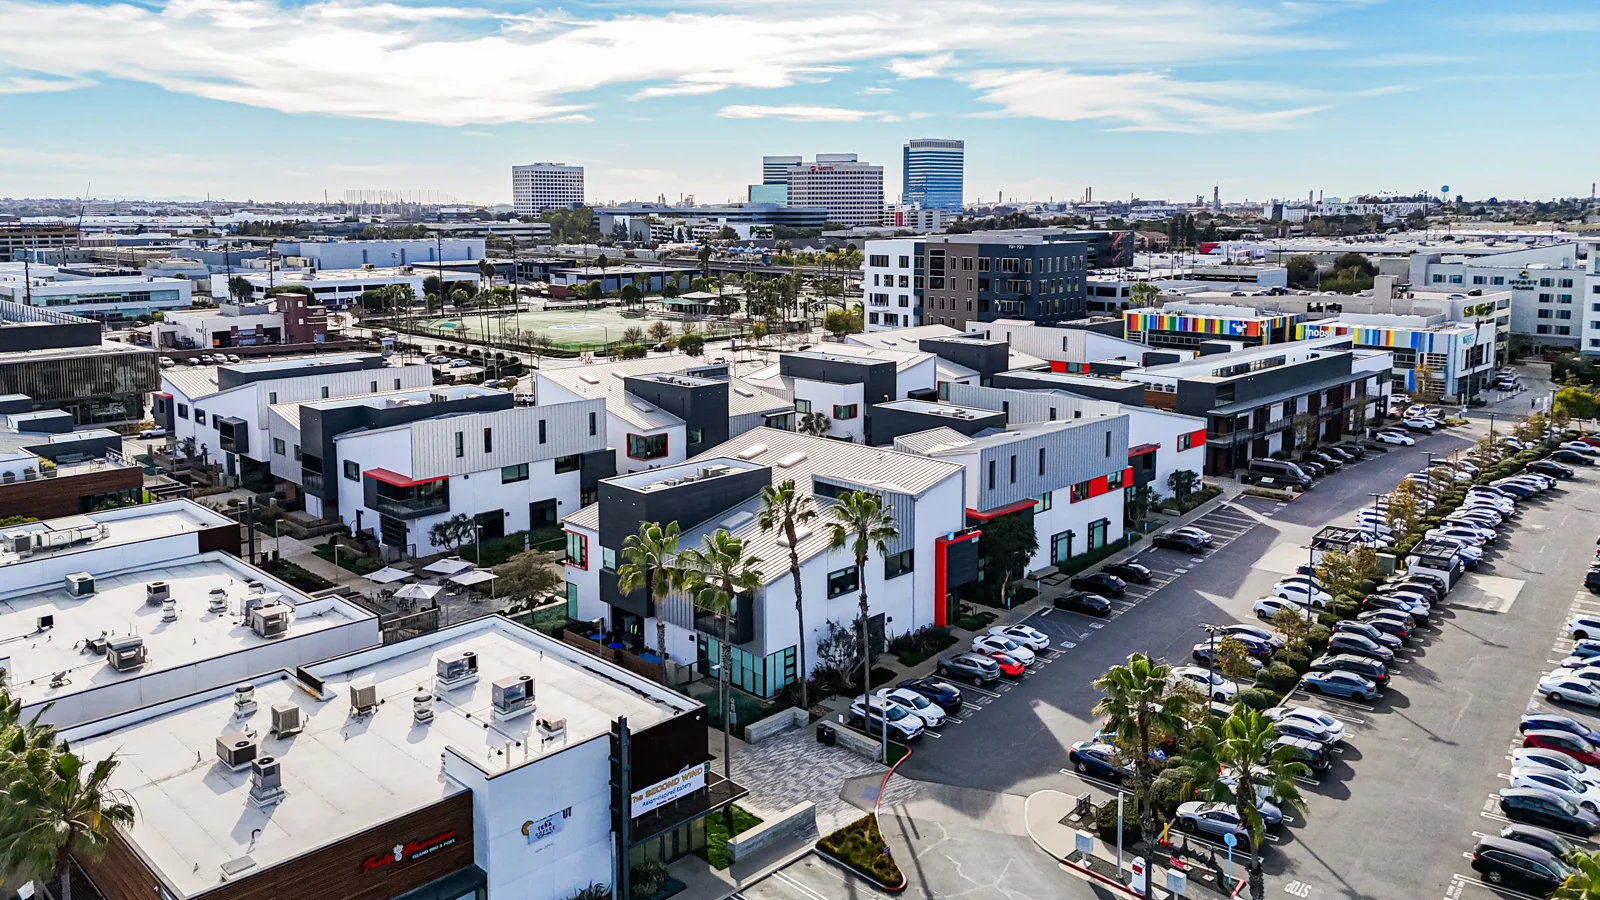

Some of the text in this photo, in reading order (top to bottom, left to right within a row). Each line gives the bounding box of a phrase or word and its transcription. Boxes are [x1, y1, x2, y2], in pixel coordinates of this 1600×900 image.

[645, 777, 680, 798] SECOND
[681, 767, 703, 781] WIND
[676, 782, 692, 793] Eatery
[535, 825, 556, 838] COFFEE
[412, 849, 429, 859] ISLAND
[1284, 880, 1312, 898] STOP
